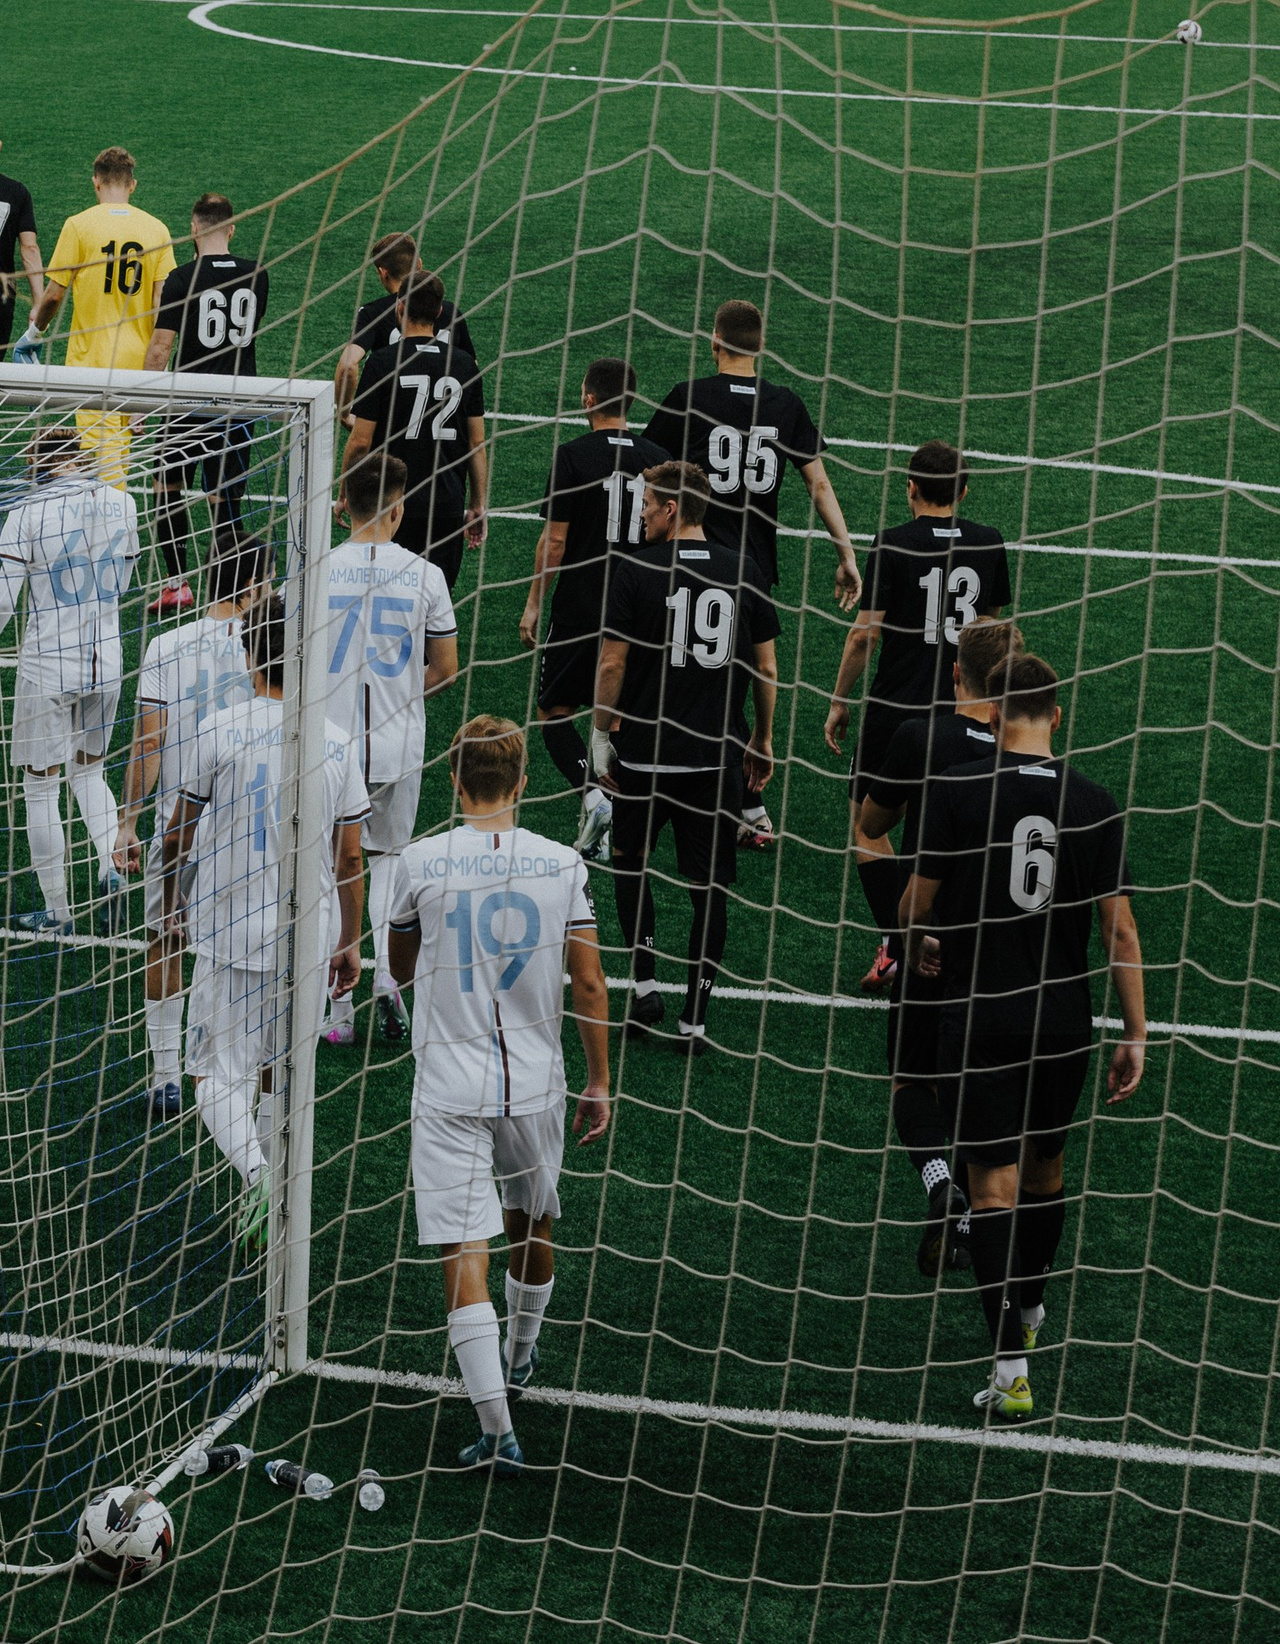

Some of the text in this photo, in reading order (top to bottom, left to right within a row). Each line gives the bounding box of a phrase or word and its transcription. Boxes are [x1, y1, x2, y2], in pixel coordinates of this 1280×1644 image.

[101, 240, 144, 296] 16
[197, 287, 258, 349] 69
[399, 374, 464, 441] 72
[708, 425, 779, 494] 95
[57, 502, 122, 522] ГУДКОВ
[603, 471, 646, 544] 11
[51, 528, 127, 606] 66
[329, 567, 419, 588] АМАЛЕТДИНОВ
[328, 595, 415, 678] 75
[666, 587, 735, 669] 19
[919, 566, 981, 646] 13
[423, 854, 561, 880] КОМИССАРОВ
[1009, 815, 1058, 912] 6
[445, 890, 541, 993] 19
